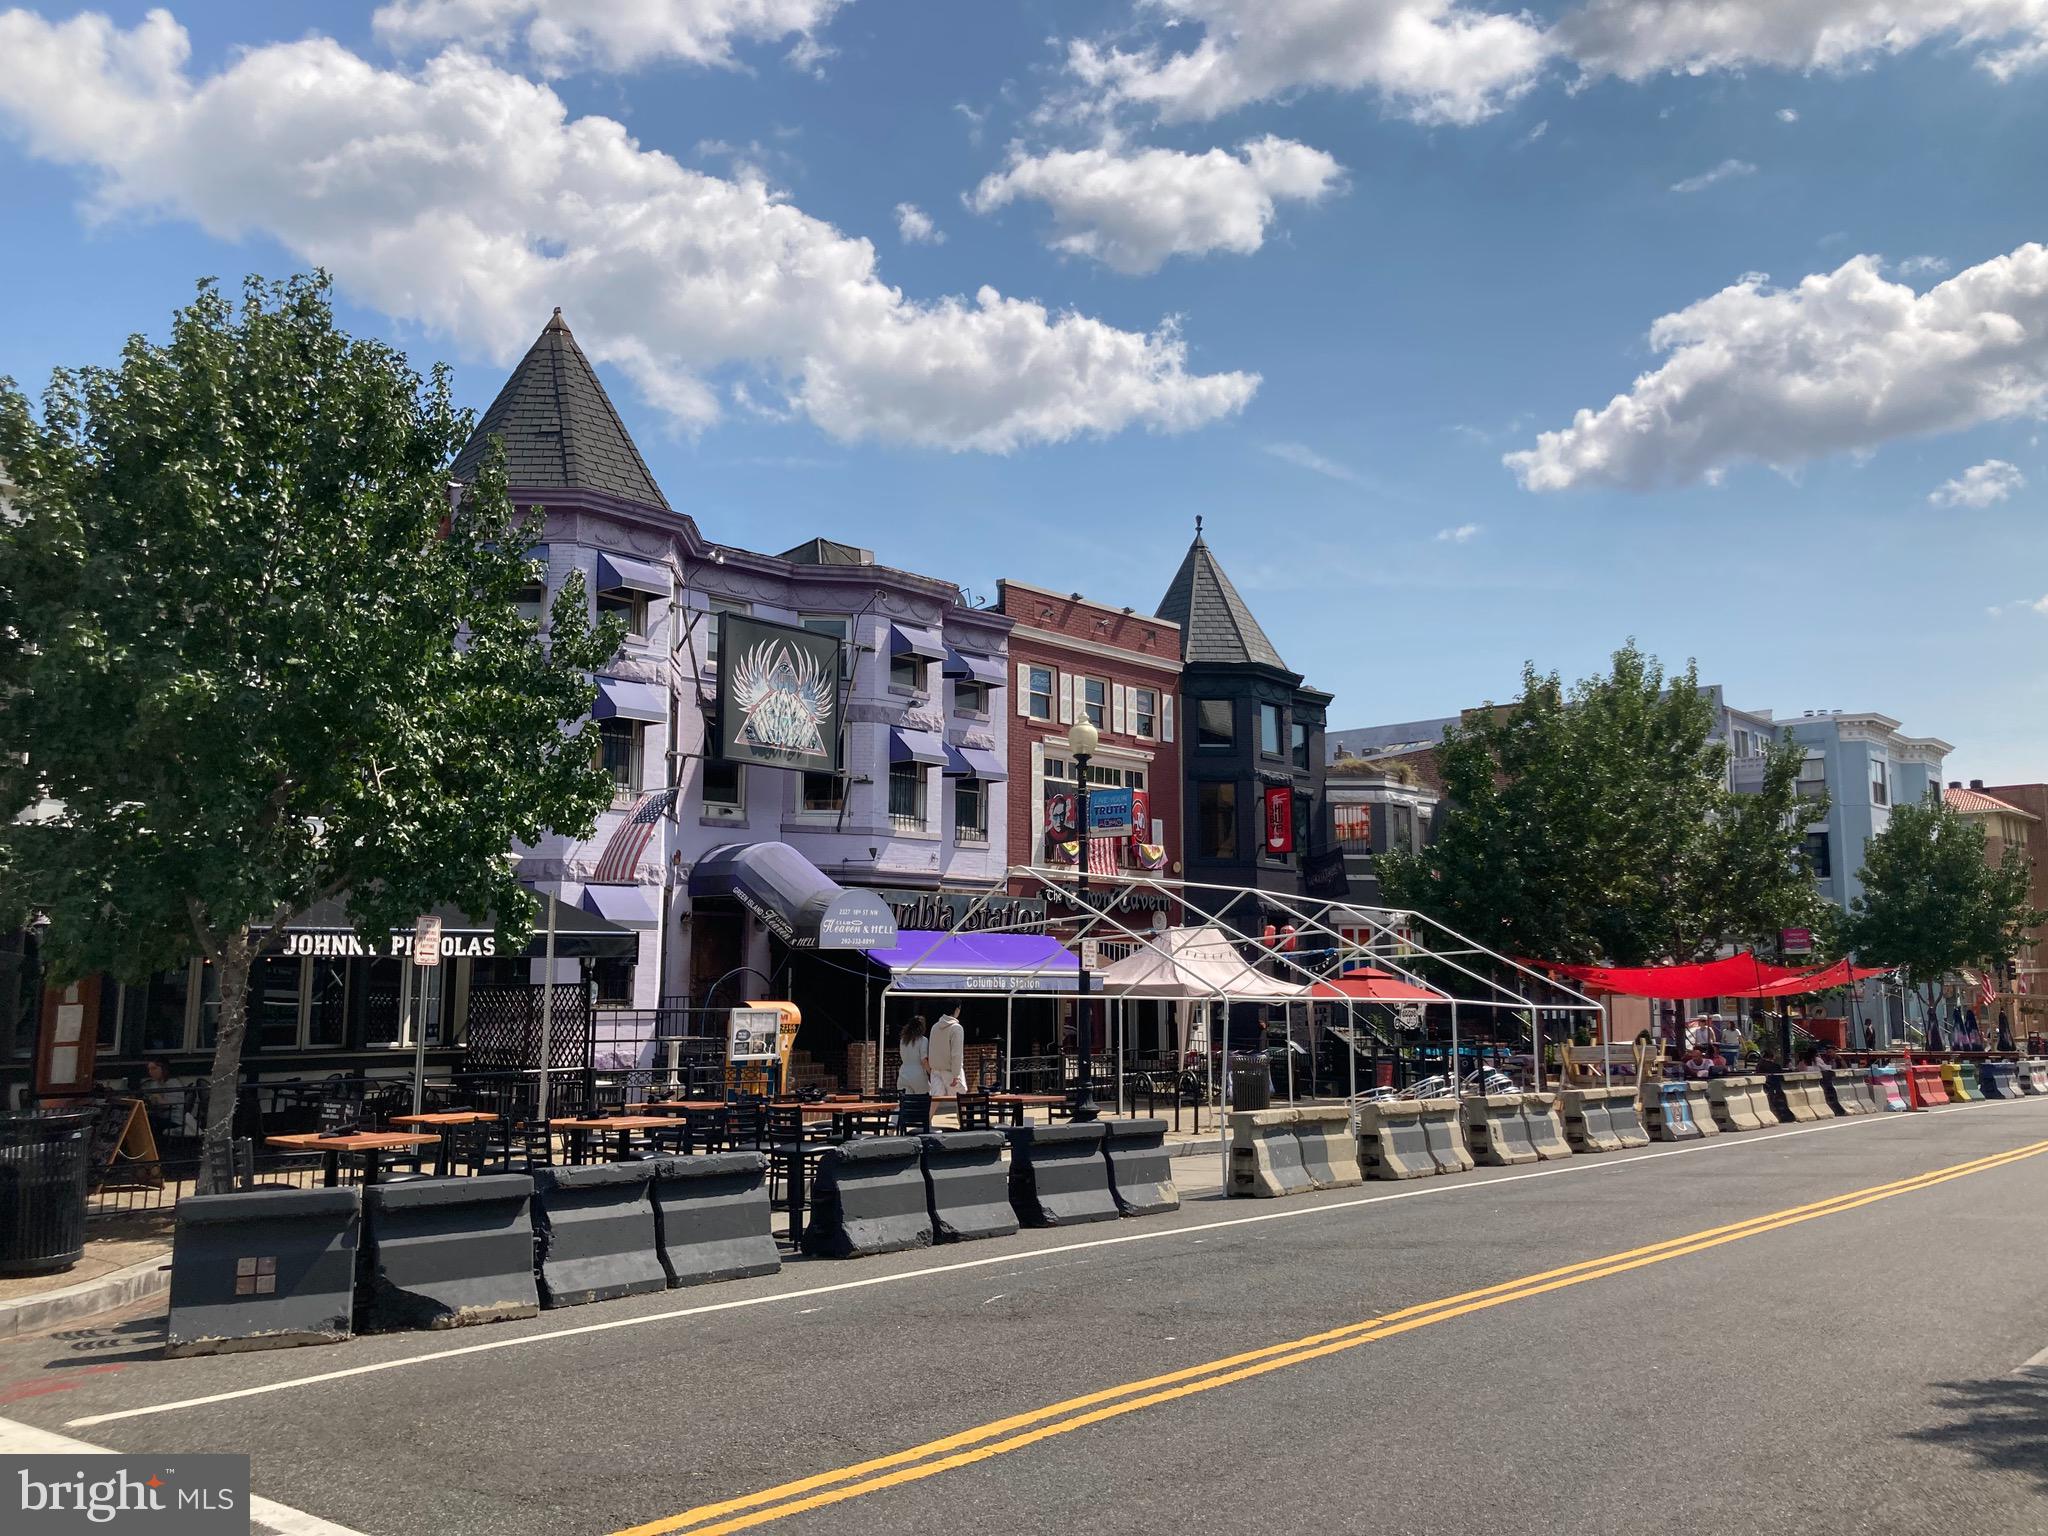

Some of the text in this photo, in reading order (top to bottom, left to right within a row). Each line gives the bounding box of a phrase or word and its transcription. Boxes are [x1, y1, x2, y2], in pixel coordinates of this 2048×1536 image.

[1094, 804, 1127, 815] TRUTH
[732, 886, 750, 903] GREEN
[746, 898, 764, 916] ISLAND
[1045, 888, 1062, 902] The
[965, 897, 1045, 934] Station
[822, 919, 895, 935] Heaven & HELL
[283, 934, 496, 956] JOHNN PIOLAS
[966, 976, 1006, 988] Columbia
